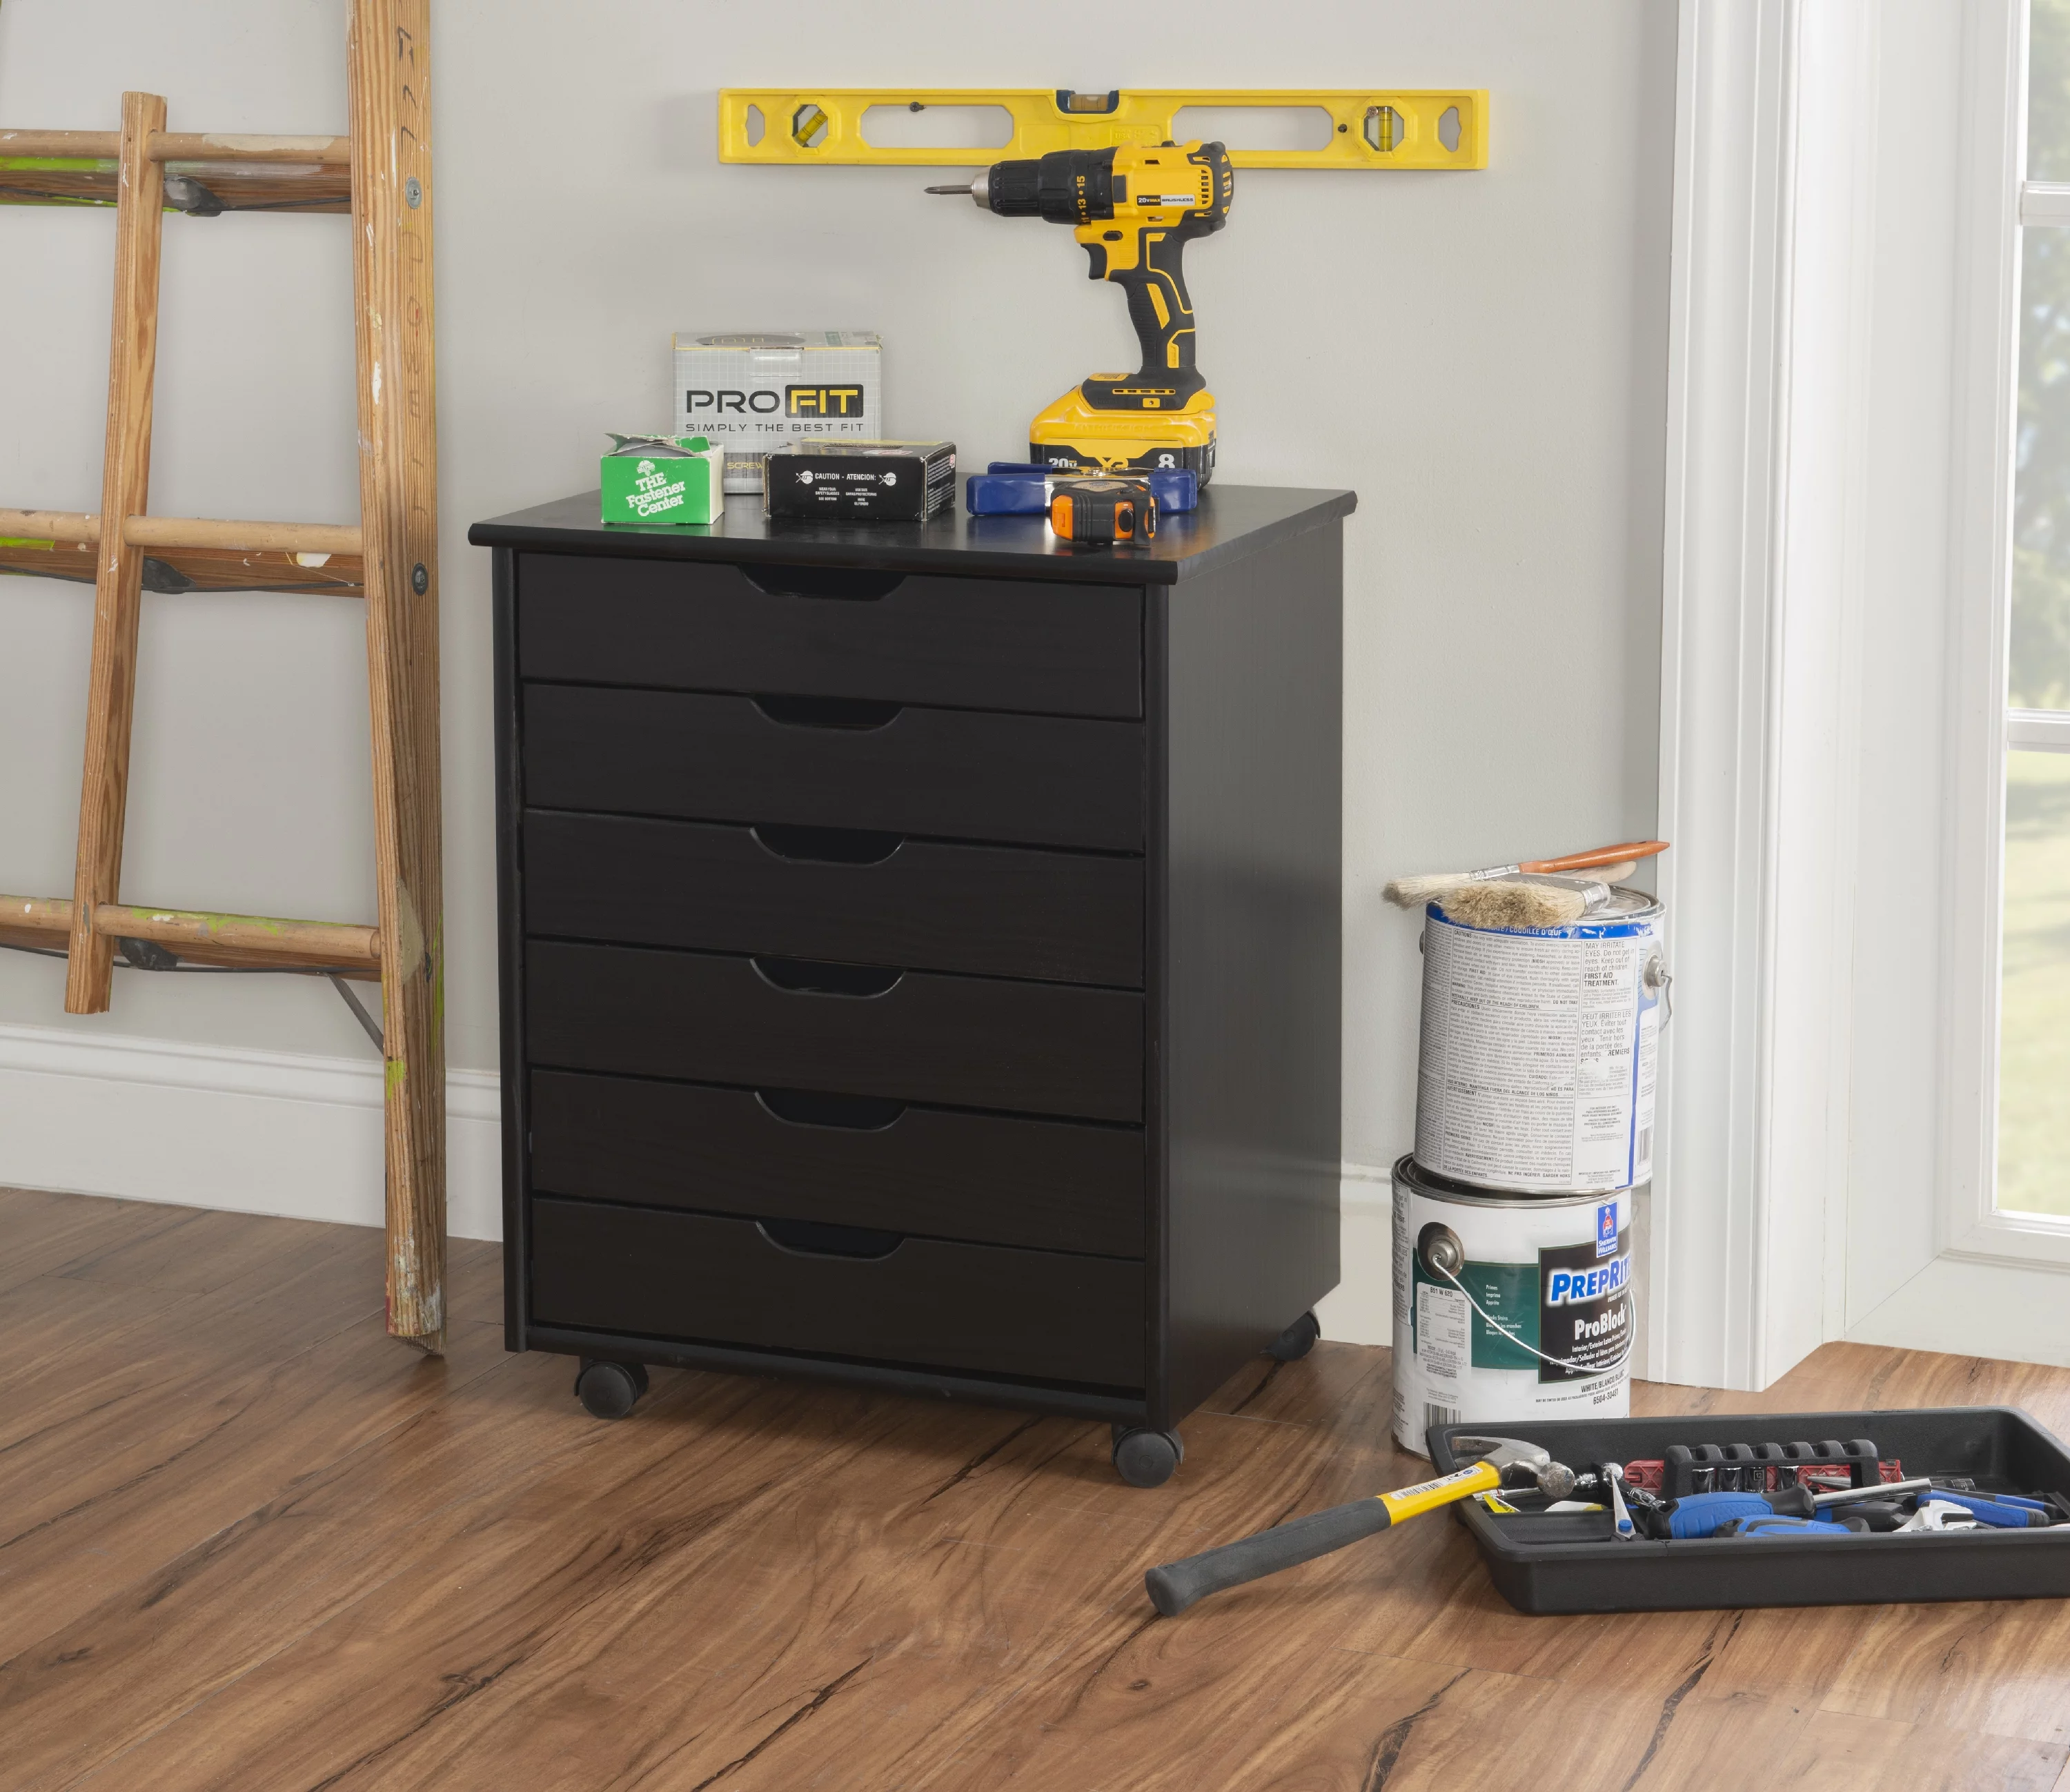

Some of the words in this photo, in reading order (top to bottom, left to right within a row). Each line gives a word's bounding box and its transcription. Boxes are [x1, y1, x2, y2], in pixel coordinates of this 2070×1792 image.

[1076, 175, 1085, 188] 15
[1077, 199, 1086, 210] 13
[686, 424, 748, 432] SIMPLY
[756, 424, 784, 432] THE
[792, 423, 833, 432] BEST
[840, 423, 864, 432] FIT
[1159, 453, 1175, 468] 8
[635, 471, 667, 492] THE
[625, 481, 687, 509] Fastener
[637, 494, 684, 517] Center
[1451, 998, 1479, 1010] PRECAUCIONES
[1596, 1043, 1613, 1051] portée
[1606, 1047, 1630, 1056] REMIERS
[1447, 1085, 1477, 1096] AVERTISSEMENT
[1598, 1236, 1617, 1247] SHERWIN
[1598, 1243, 1617, 1254] WILLIAMS
[1551, 1256, 1630, 1301] PREPRIT
[1575, 1303, 1626, 1340] ProBlock
[1572, 1340, 1603, 1352] Interior/Exterior
